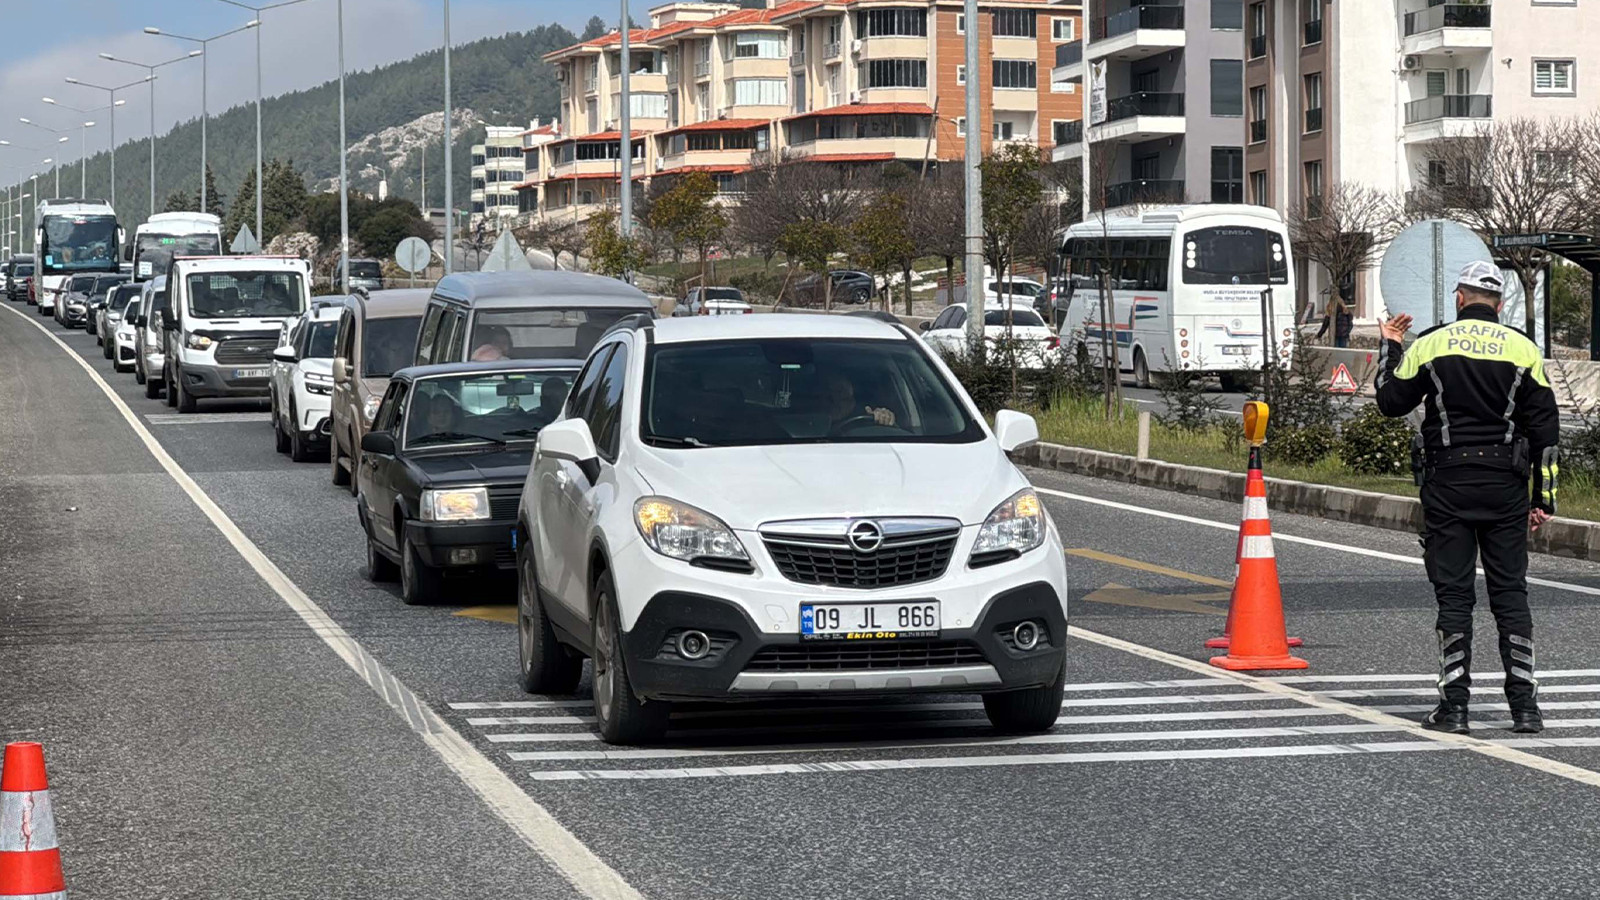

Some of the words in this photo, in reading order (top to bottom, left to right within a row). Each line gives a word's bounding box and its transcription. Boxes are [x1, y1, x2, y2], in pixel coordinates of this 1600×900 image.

[1446, 324, 1508, 341] TRAFİK
[1448, 338, 1503, 355] POLİSİ
[803, 621, 813, 629] TR
[815, 608, 840, 630] 09
[857, 607, 882, 629] JL
[898, 605, 935, 628] 866
[847, 632, 873, 640] Ekin
[876, 631, 897, 639] Oto
